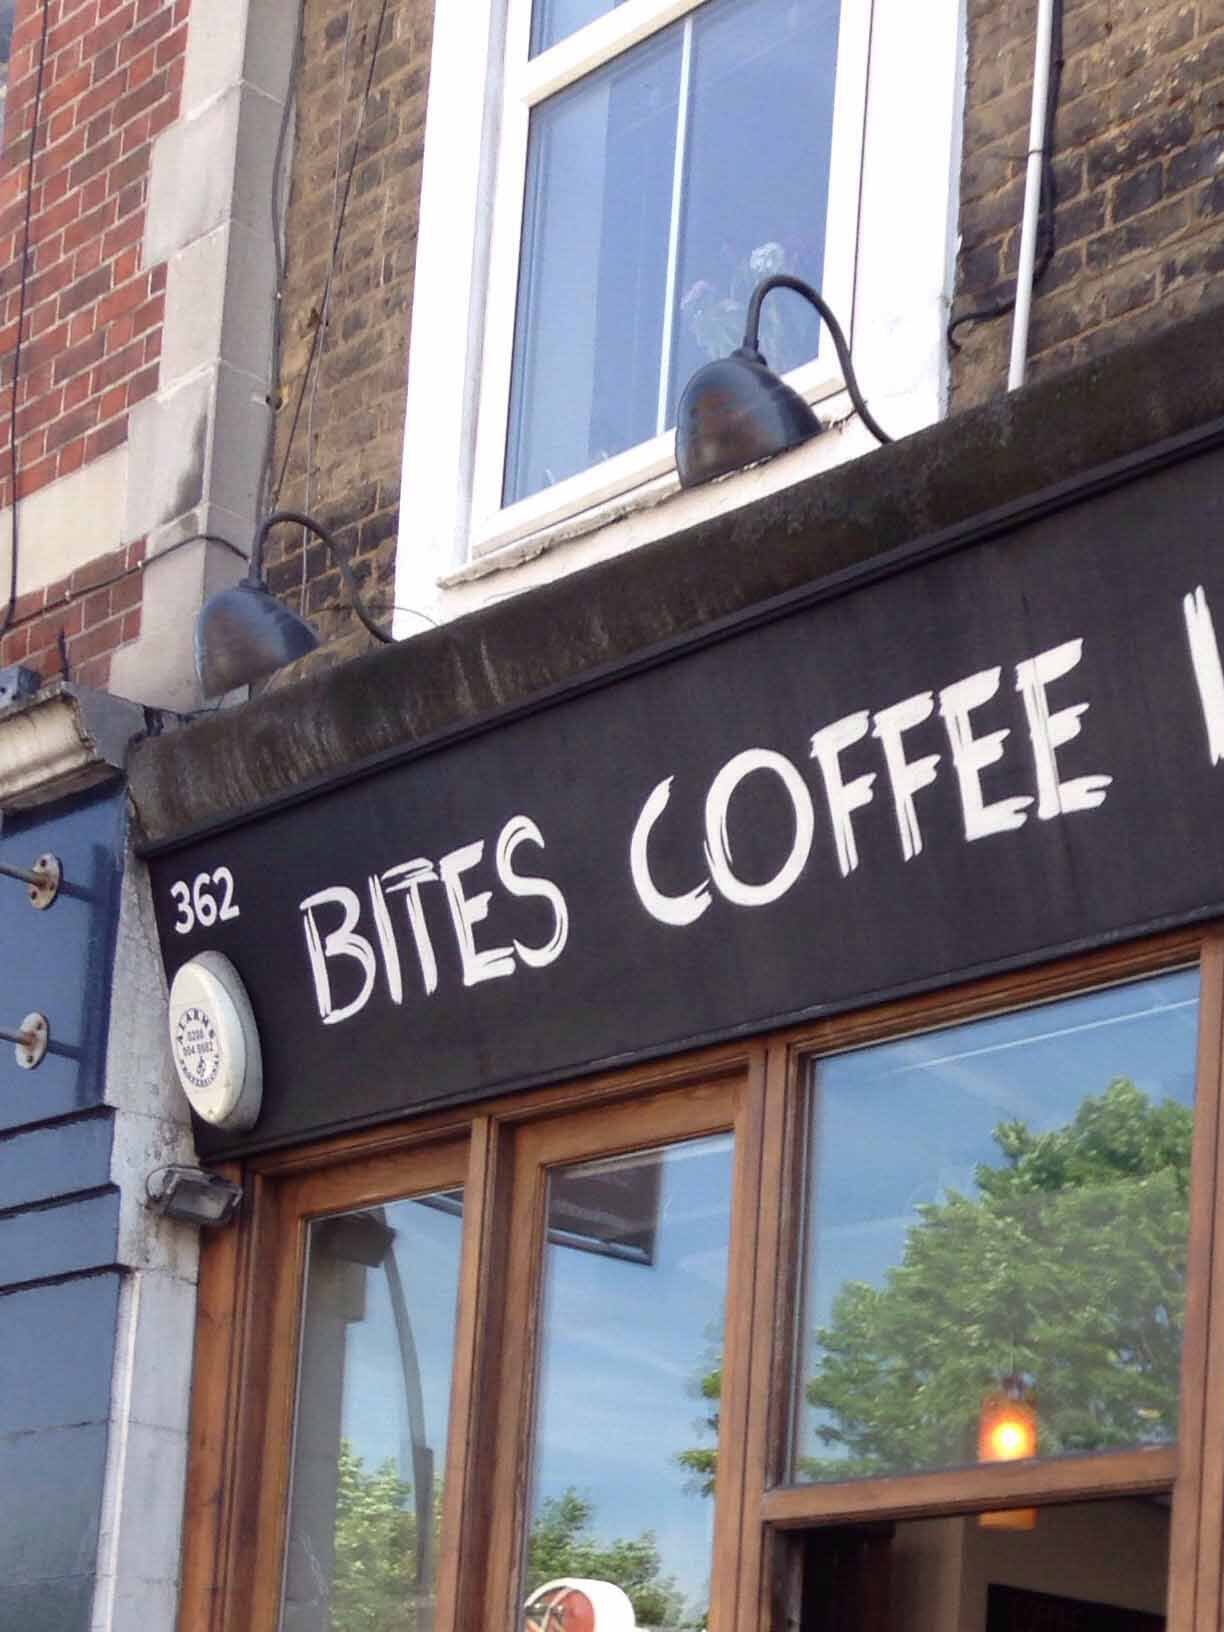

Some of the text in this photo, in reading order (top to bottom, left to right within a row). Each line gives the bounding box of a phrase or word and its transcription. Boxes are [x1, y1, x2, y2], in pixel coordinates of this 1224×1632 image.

[170, 866, 240, 934] 362
[299, 815, 570, 1025] BITES
[629, 637, 1113, 927] COFFEE
